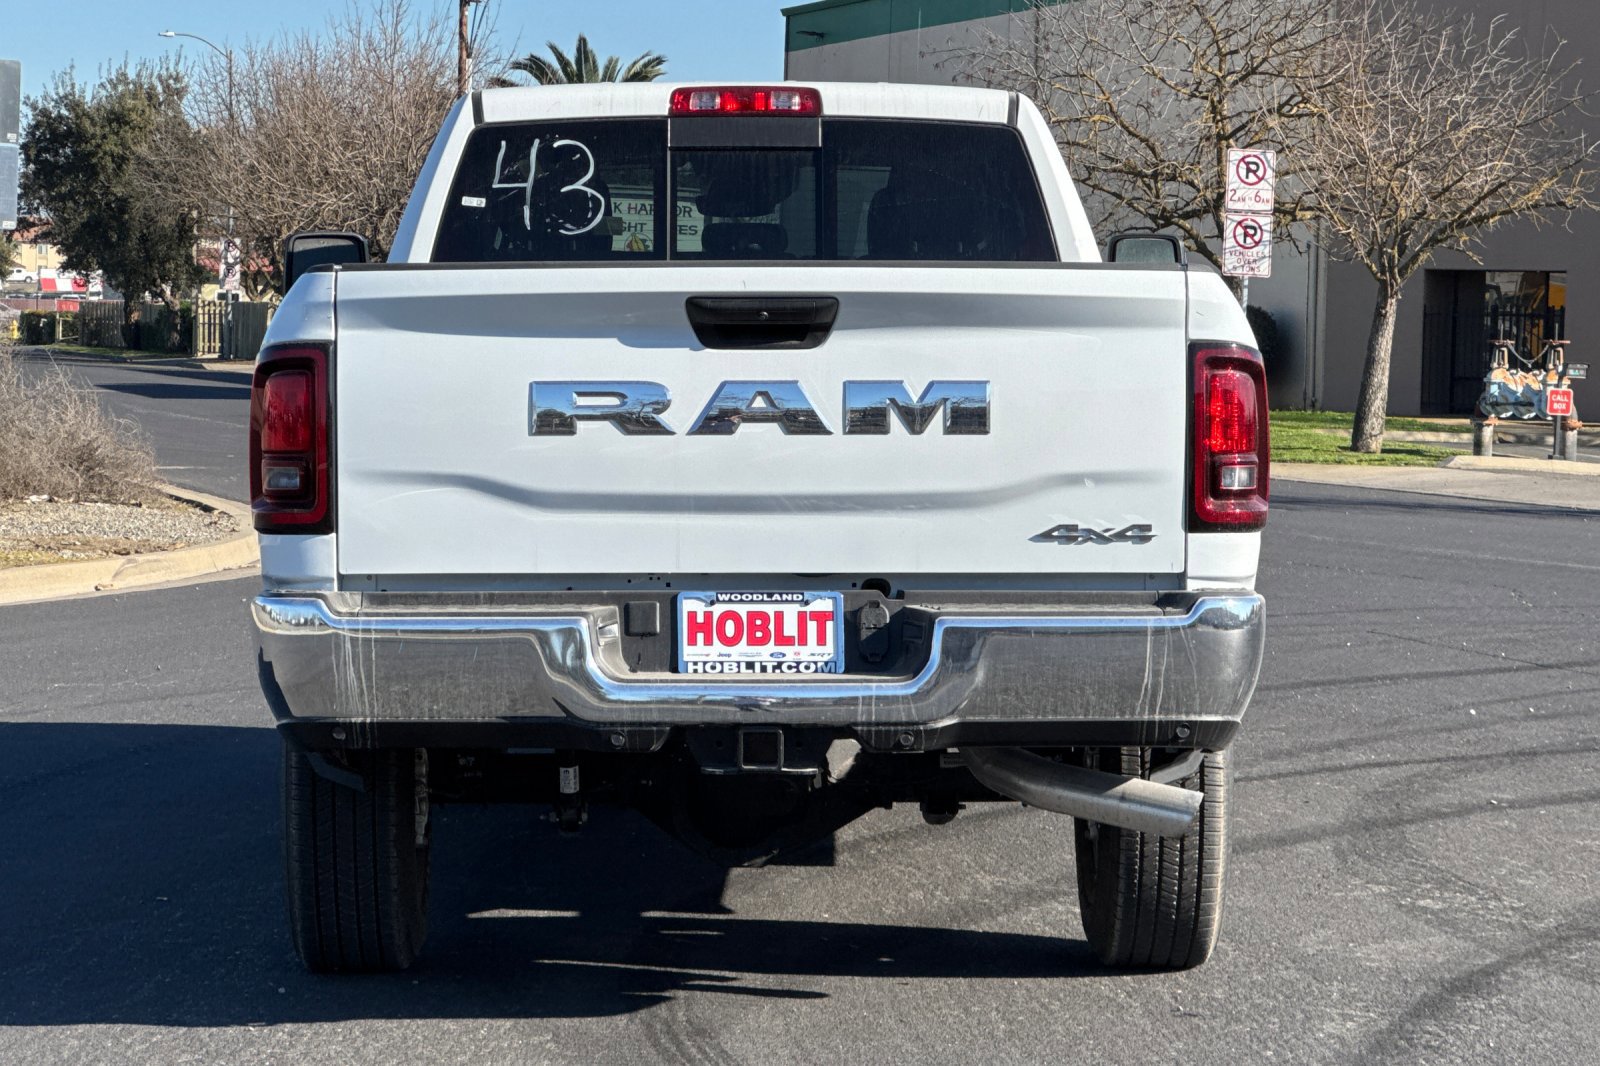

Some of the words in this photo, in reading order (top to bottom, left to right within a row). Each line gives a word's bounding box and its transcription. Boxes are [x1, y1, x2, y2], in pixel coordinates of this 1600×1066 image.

[492, 138, 605, 235] 43
[1551, 394, 1569, 402] CALL
[528, 379, 991, 436] RAM
[1553, 402, 1567, 410] BOX
[717, 593, 804, 601] WOODLAND
[687, 610, 834, 647] HOBLIT
[687, 661, 836, 674] HOBLIT.COM
